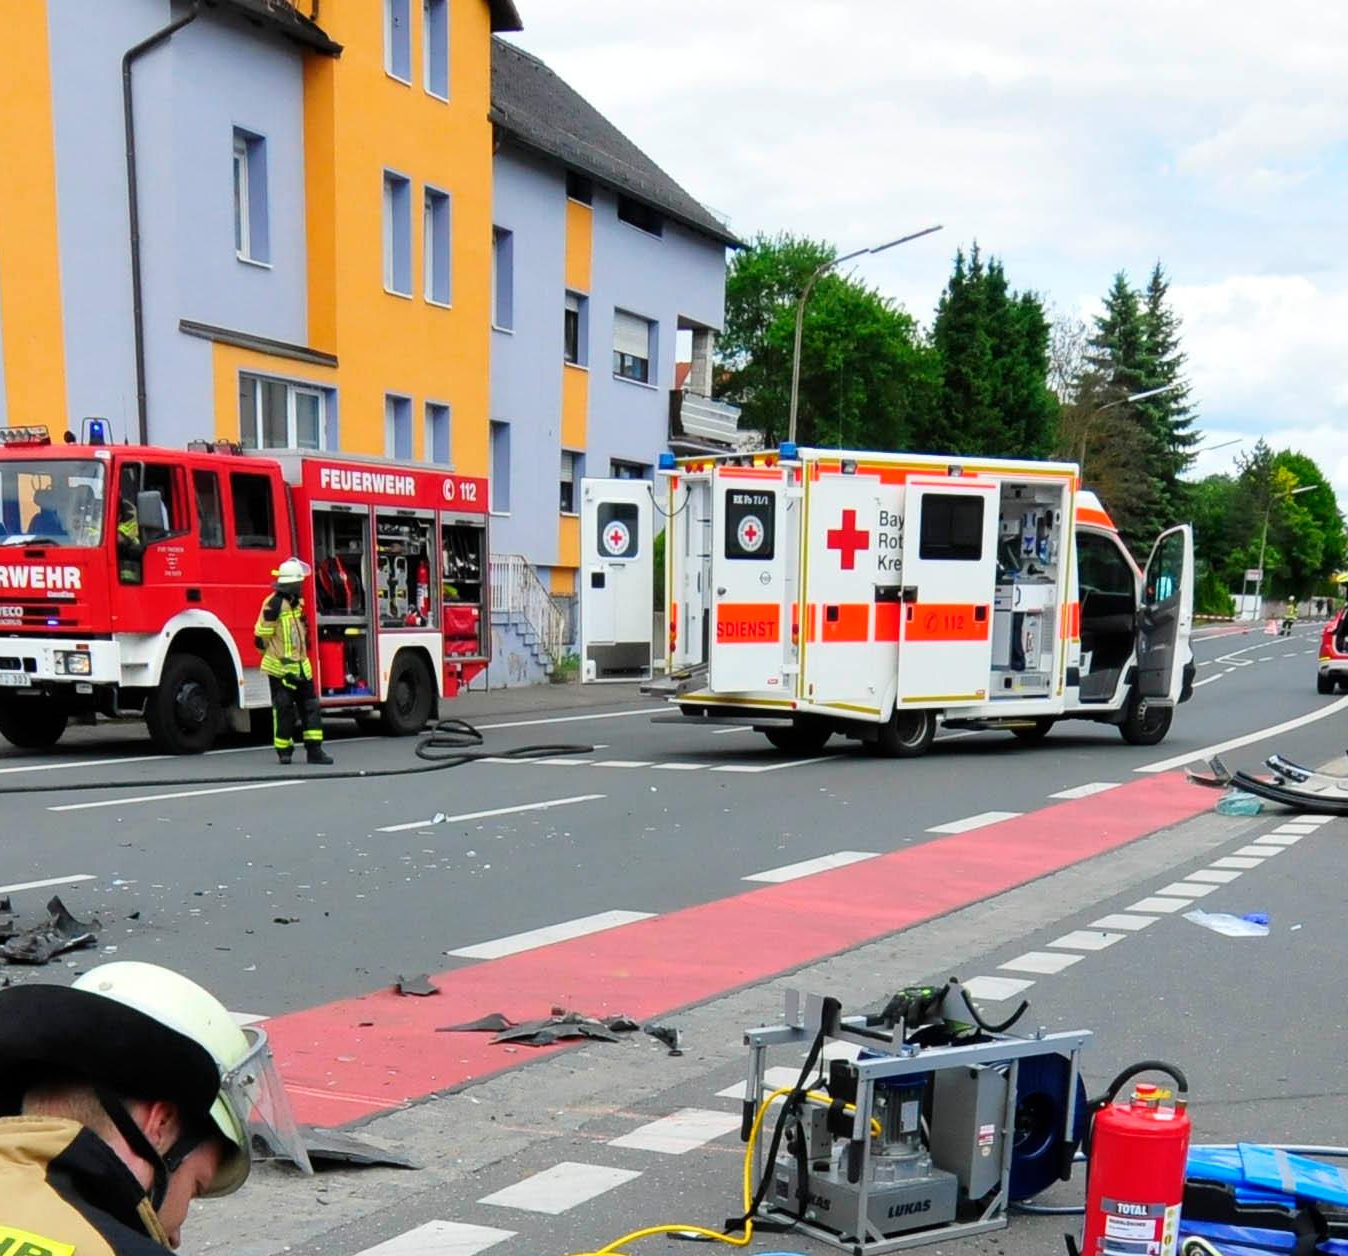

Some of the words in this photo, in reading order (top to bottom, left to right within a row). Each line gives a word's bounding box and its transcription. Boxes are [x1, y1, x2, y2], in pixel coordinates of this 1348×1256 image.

[320, 468, 415, 496] FEUERWEHR
[459, 482, 477, 501] 112
[879, 510, 903, 529] Bay
[877, 554, 901, 571] Kre
[717, 622, 774, 637] SDIENST
[943, 615, 964, 630] 112
[888, 1199, 932, 1219] LUKAS
[1117, 1203, 1149, 1216] TOTAL
